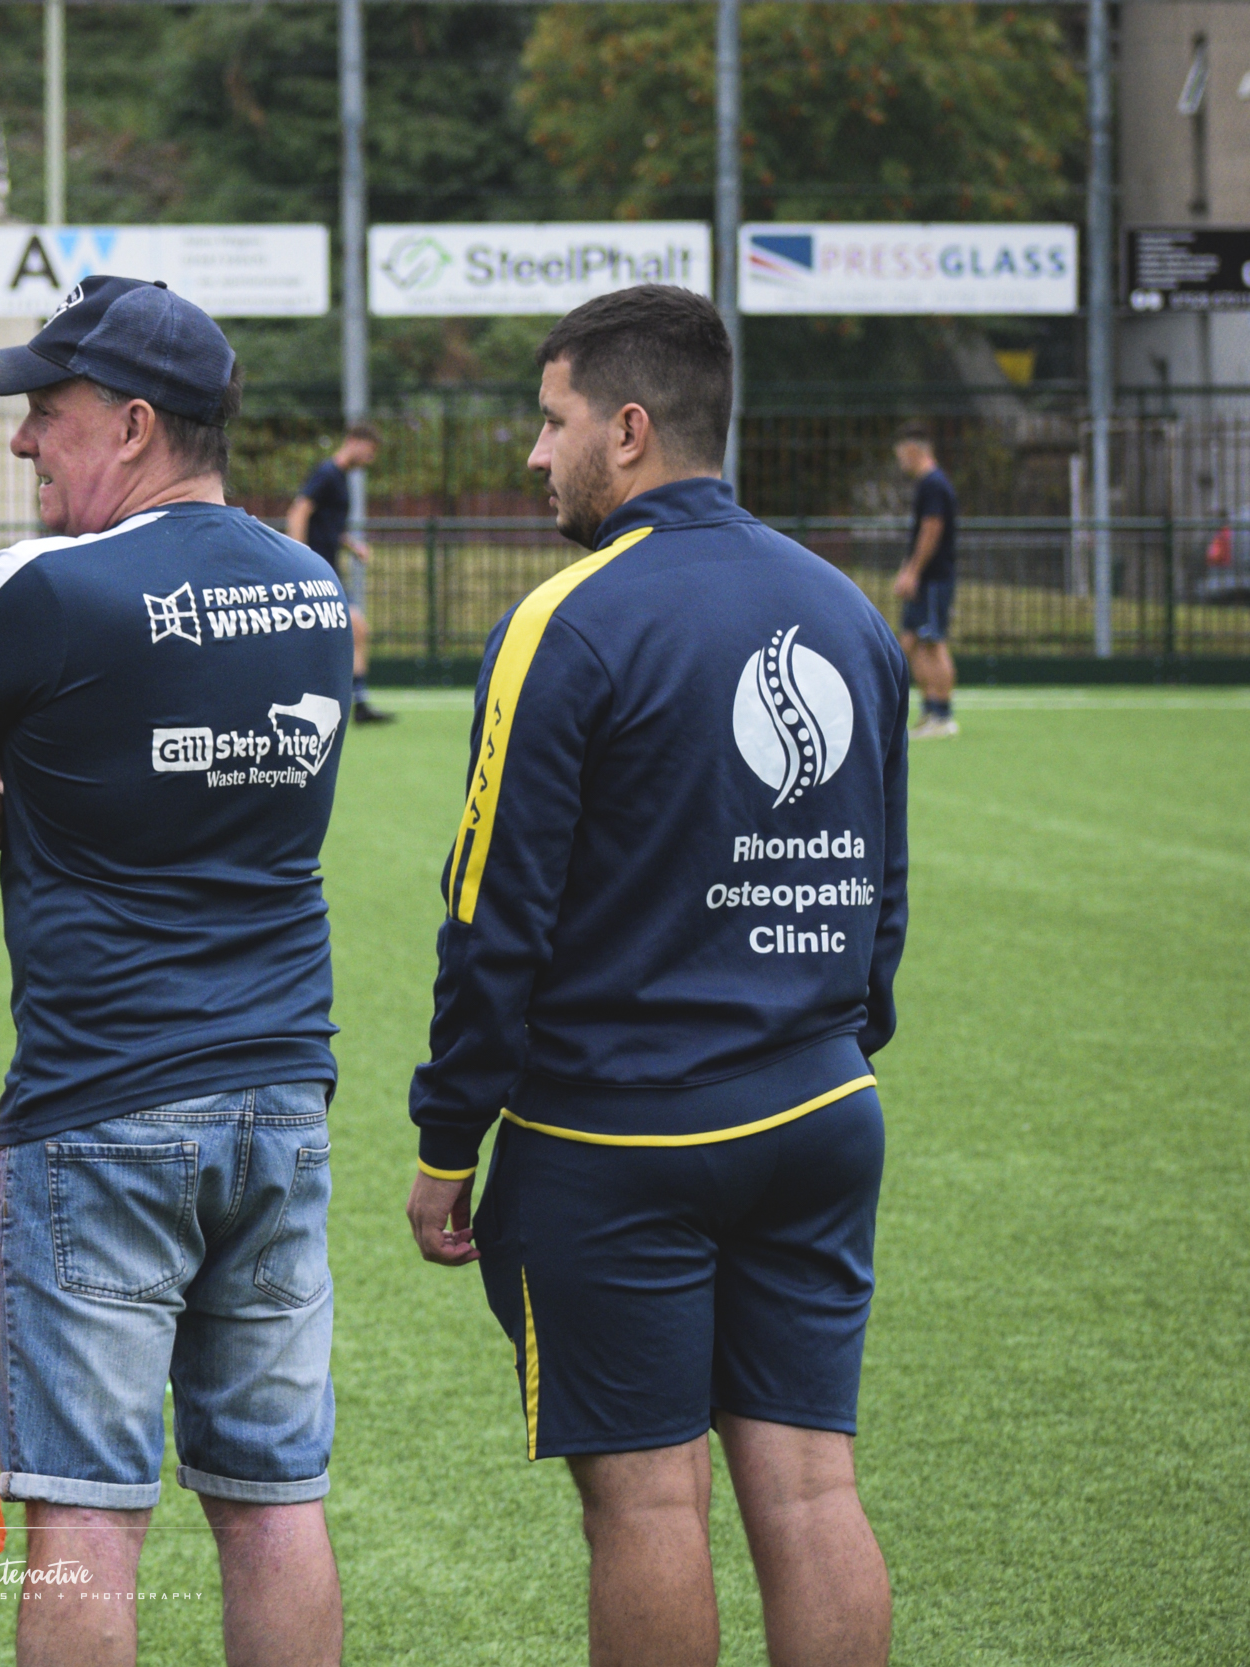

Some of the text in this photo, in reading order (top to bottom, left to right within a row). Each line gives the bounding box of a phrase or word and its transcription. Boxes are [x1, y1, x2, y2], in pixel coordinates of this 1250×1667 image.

[464, 244, 691, 285] SteelPhalt
[202, 580, 339, 607] FRAME OF MIND
[206, 601, 348, 638] WINDOWS
[159, 736, 207, 763] Gill
[276, 728, 319, 756] hire
[207, 766, 308, 788] Waste Recycling
[733, 830, 865, 862] Rhondda
[706, 877, 875, 913] Osteopathic
[749, 924, 846, 954] Clinic
